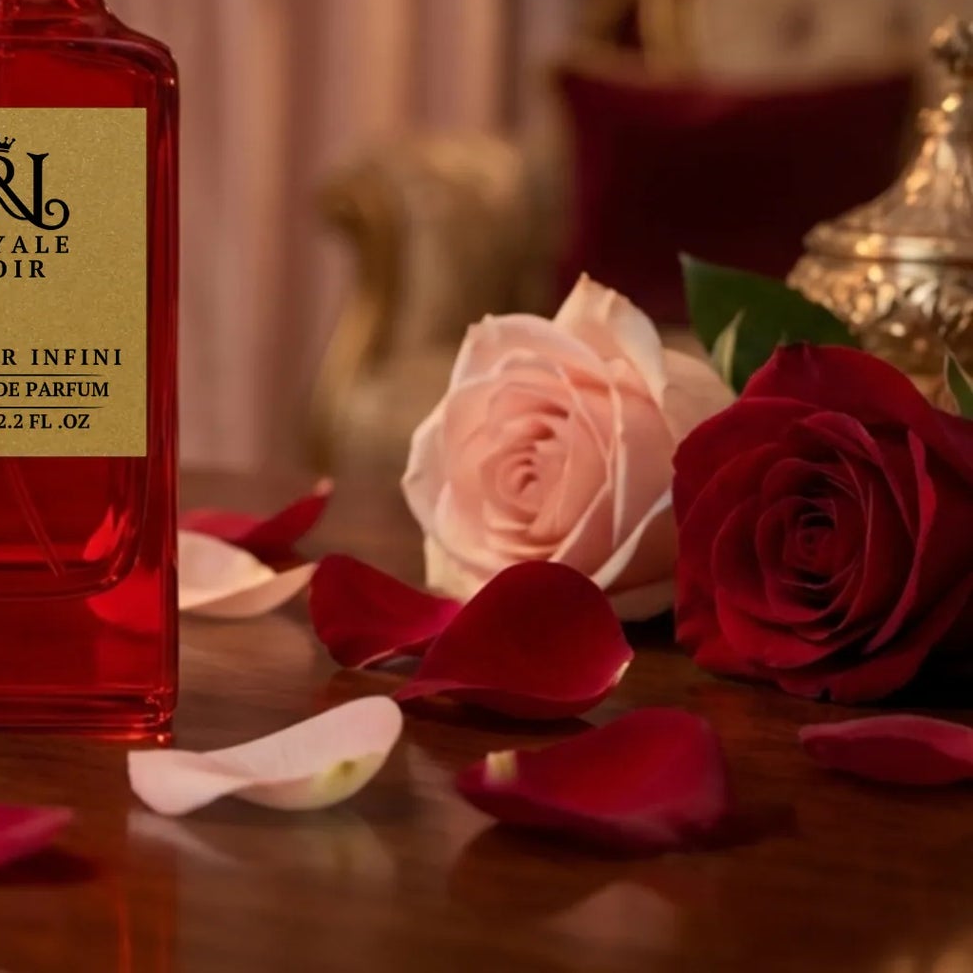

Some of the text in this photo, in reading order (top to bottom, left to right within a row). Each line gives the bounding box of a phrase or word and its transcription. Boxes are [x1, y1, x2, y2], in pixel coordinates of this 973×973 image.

[31, 348, 122, 366] INFINI
[25, 381, 109, 398] PARFUM
[29, 413, 53, 430] FL
